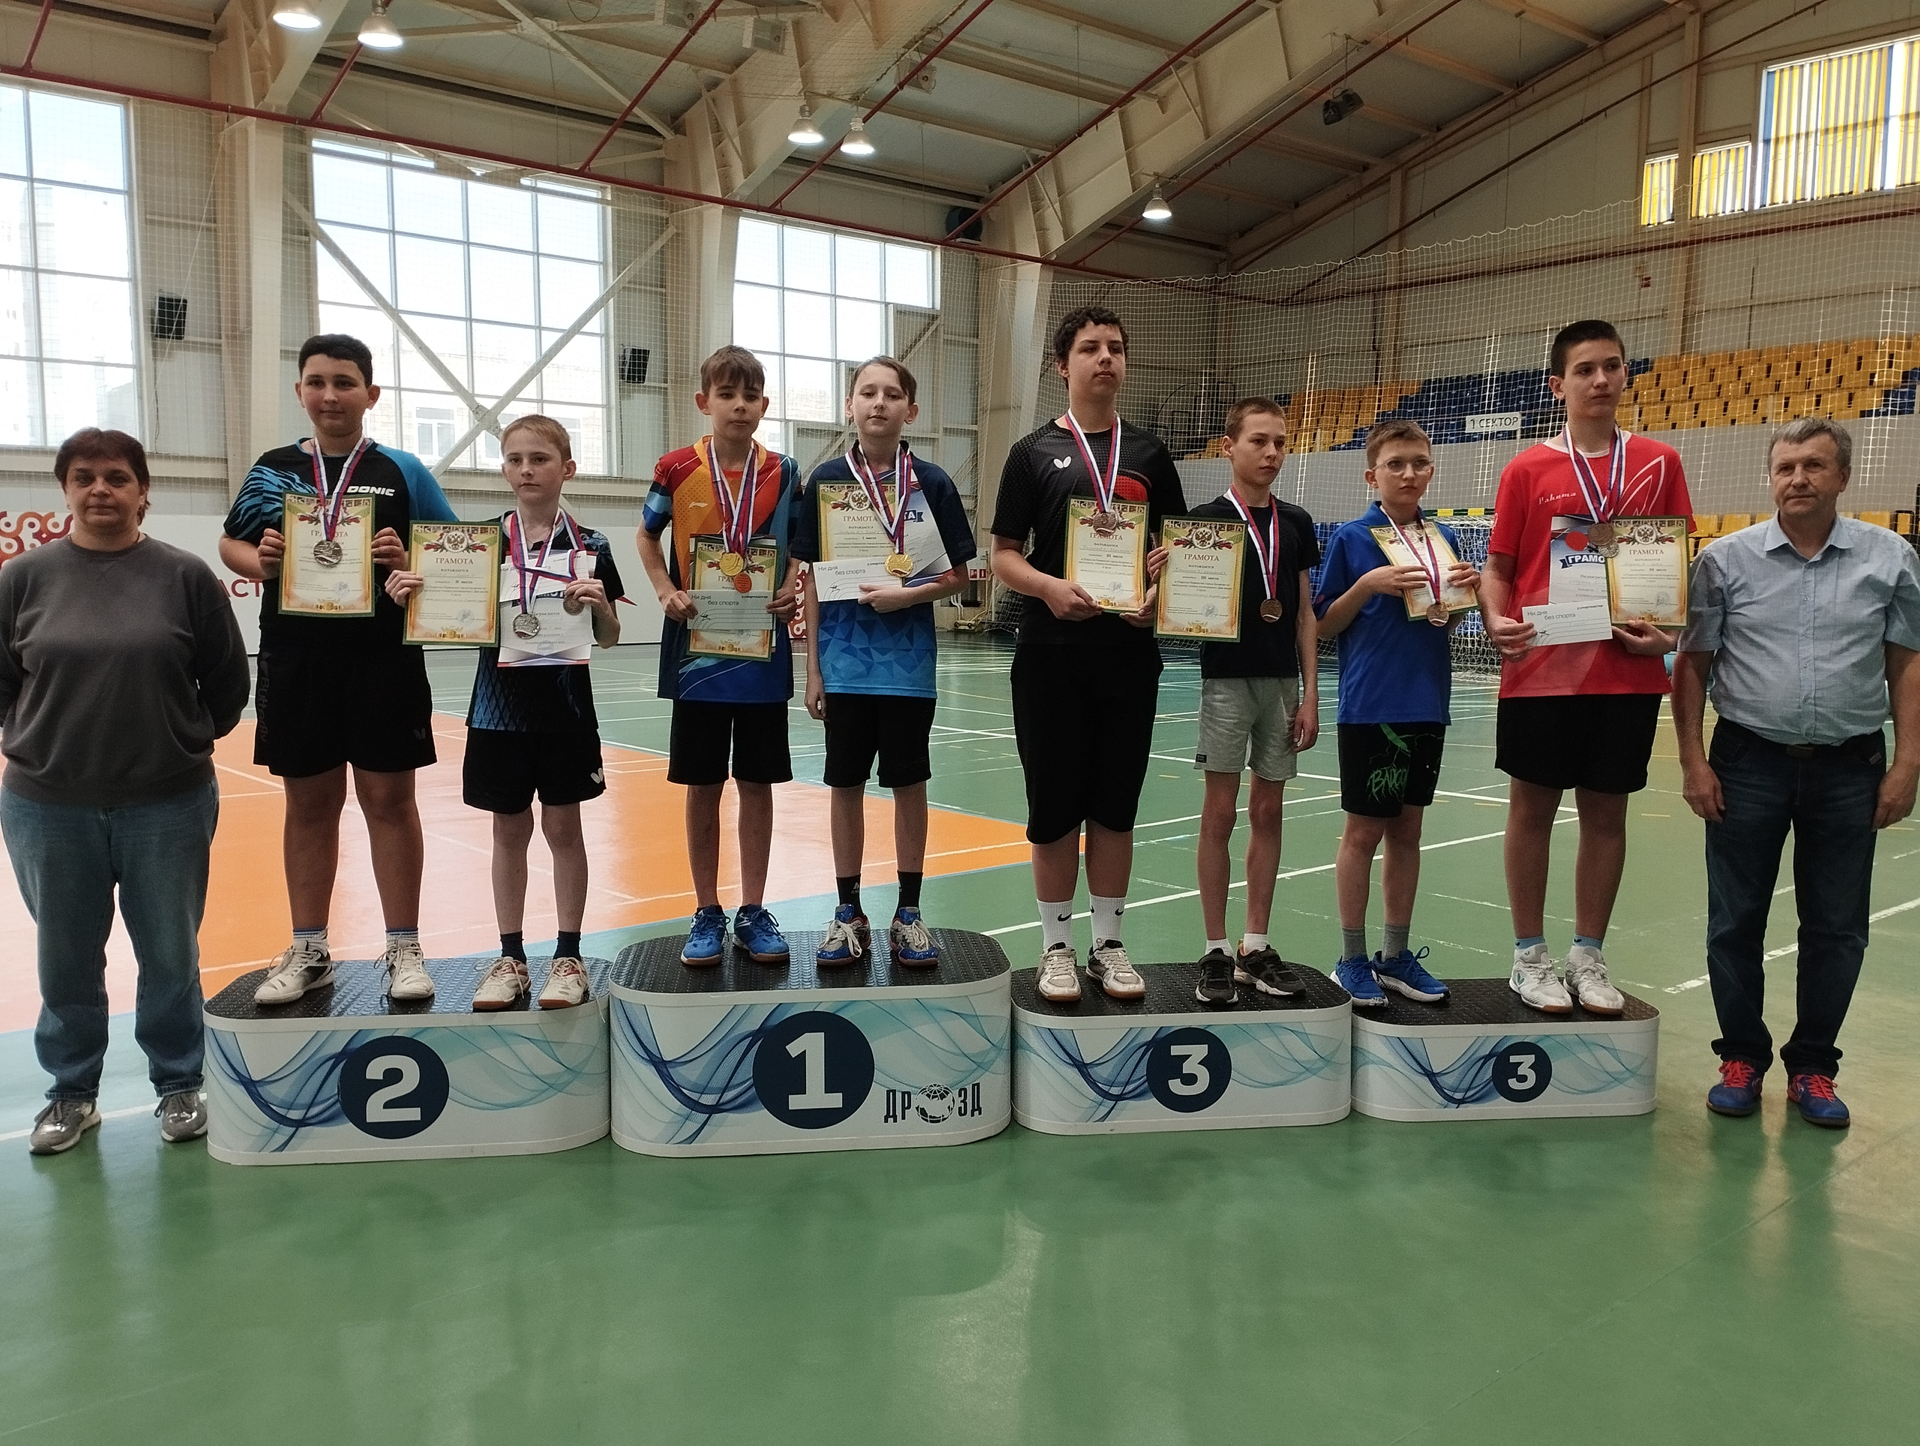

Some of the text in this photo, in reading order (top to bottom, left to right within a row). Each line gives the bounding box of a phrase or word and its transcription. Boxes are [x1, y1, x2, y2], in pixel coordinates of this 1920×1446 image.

[1470, 416, 1519, 429] 1 СЕКТОР
[346, 485, 396, 497] DONIC
[435, 557, 474, 565] ГРАМОТА
[1184, 553, 1220, 562] ГРАМОТА
[1567, 554, 1606, 564] ГРАМО
[846, 568, 866, 576] спорта
[785, 1032, 843, 1110] 1
[1168, 1044, 1210, 1096] 3
[1508, 1054, 1537, 1090] 3
[366, 1054, 421, 1123] 2
